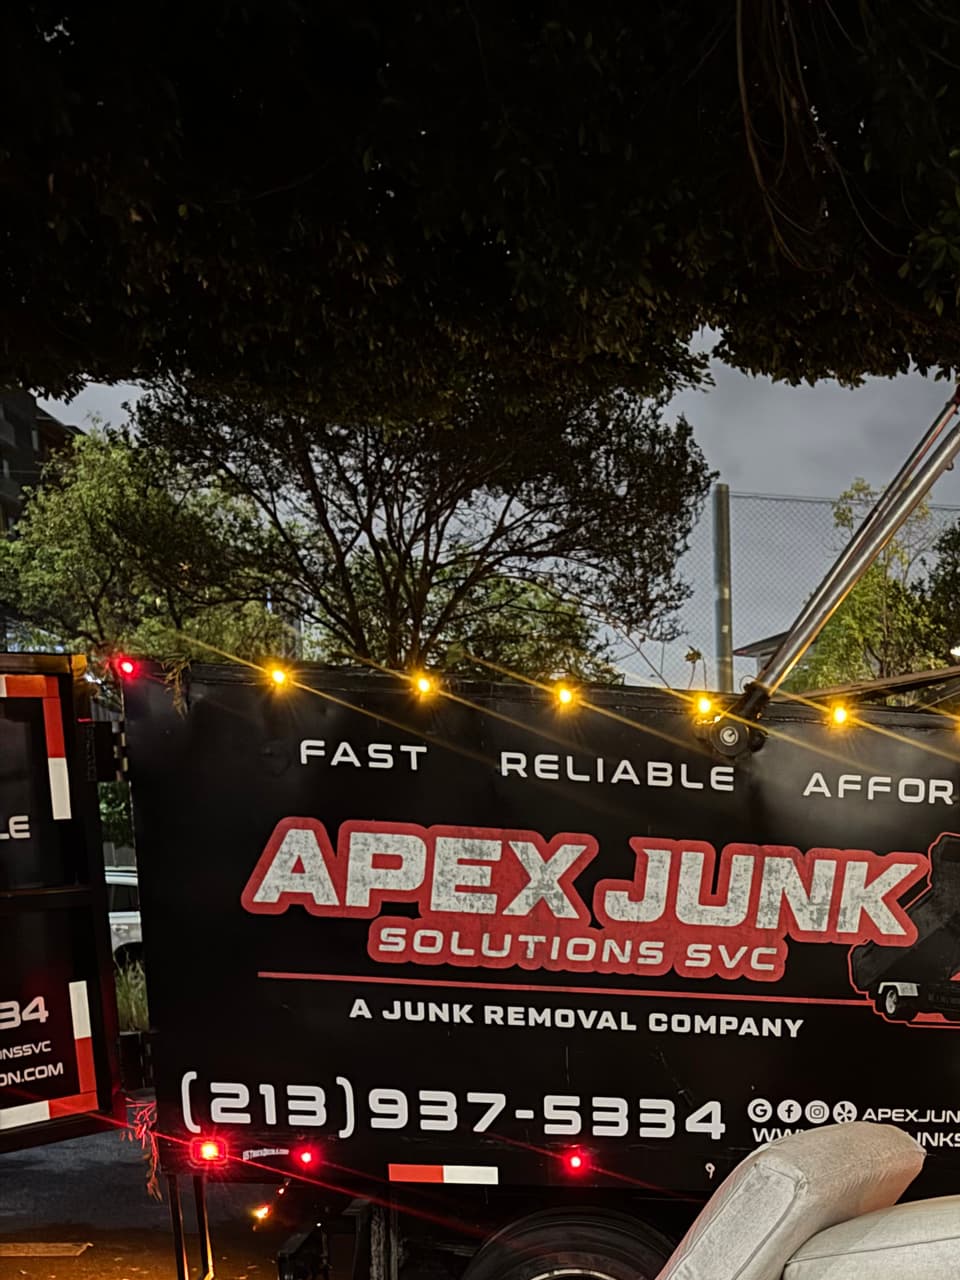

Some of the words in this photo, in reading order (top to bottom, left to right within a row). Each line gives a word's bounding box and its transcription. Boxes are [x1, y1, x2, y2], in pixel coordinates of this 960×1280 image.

[301, 739, 427, 771] FAST
[501, 751, 735, 792] RELIABLE
[252, 828, 587, 919] APEX
[603, 848, 918, 936] JUNK
[378, 927, 665, 965] SOLUTIONS
[684, 943, 777, 971] SVC
[349, 998, 373, 1019] A
[382, 1000, 474, 1024] JUNK
[484, 1005, 637, 1031] REMOVAL
[648, 1012, 804, 1038] COMPANY
[181, 1071, 726, 1140] (213)937-5334
